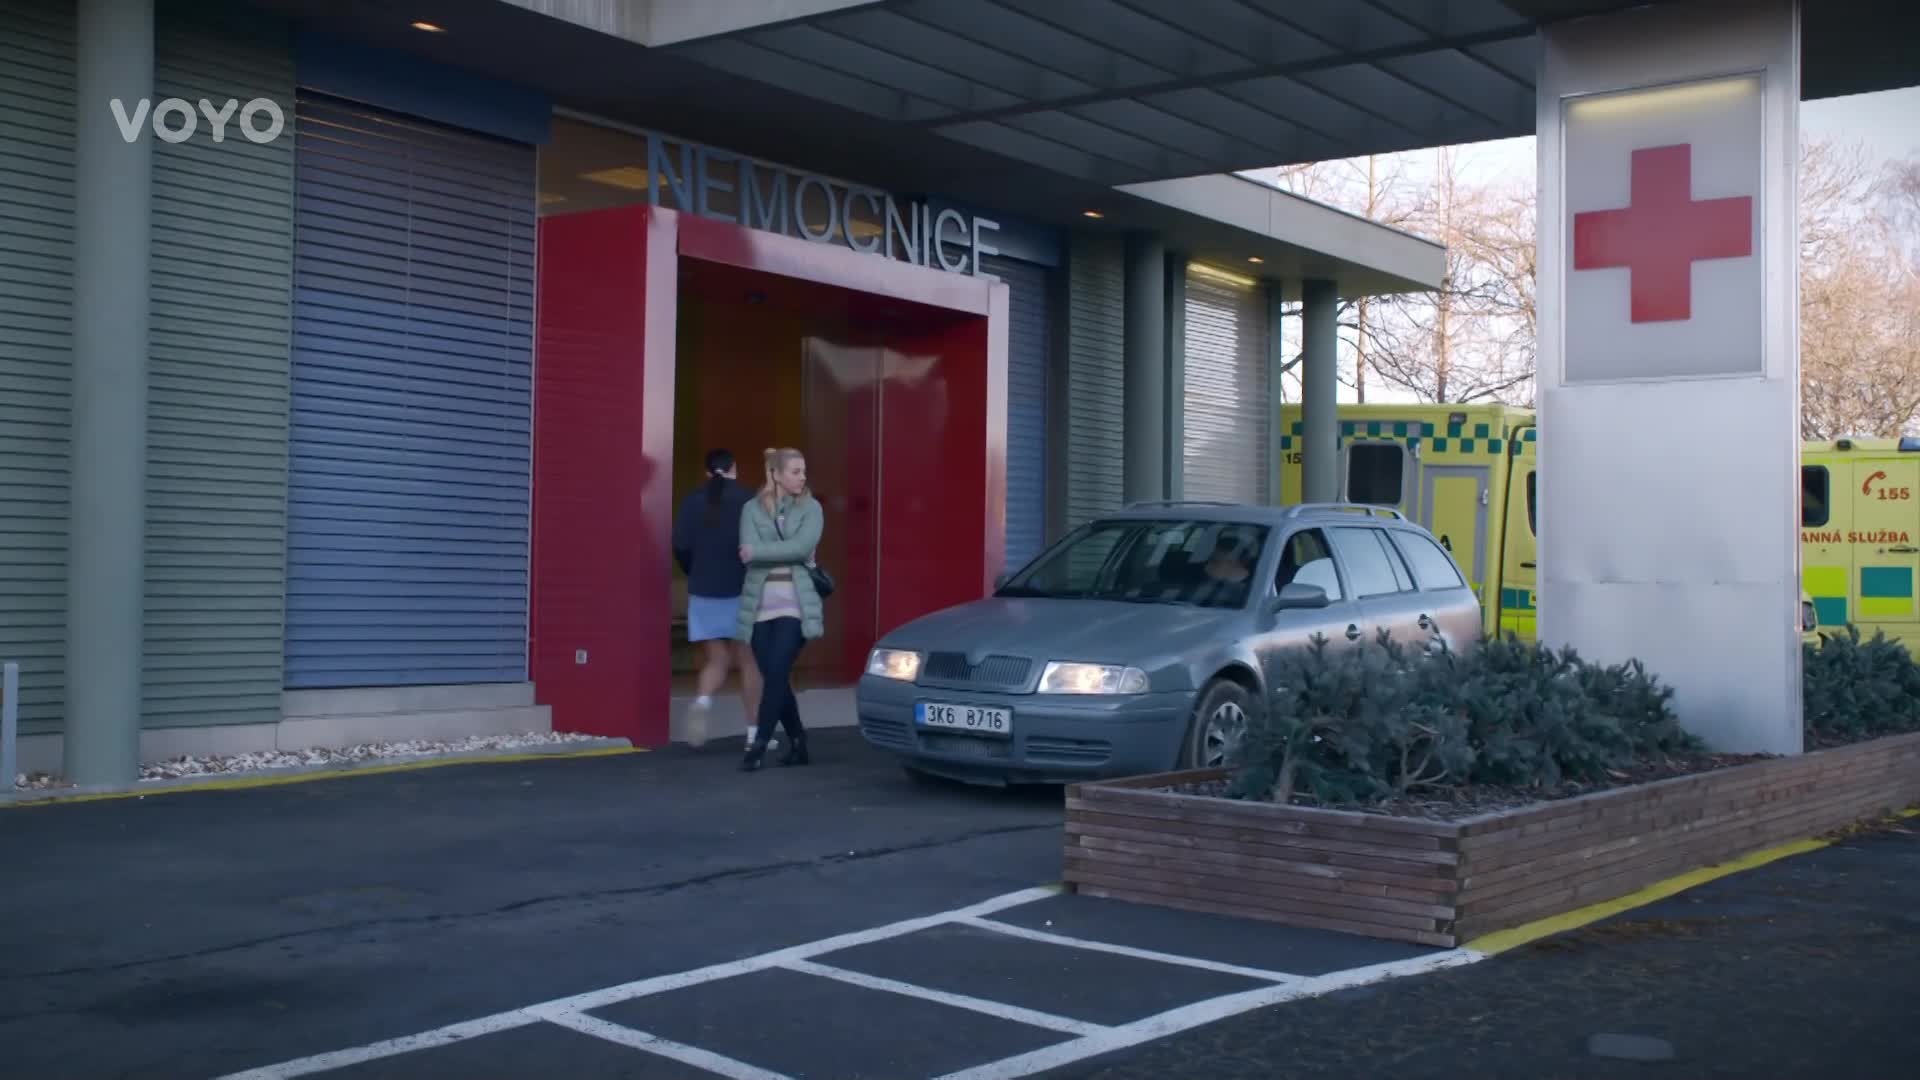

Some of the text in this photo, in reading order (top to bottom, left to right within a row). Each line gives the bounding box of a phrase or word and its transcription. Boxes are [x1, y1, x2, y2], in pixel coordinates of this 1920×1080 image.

[646, 132, 1001, 280] NEMOCNICE
[1877, 487, 1910, 500] 155
[1848, 529, 1909, 543] SLUŽBA
[927, 705, 1003, 730] 3K6 8716
